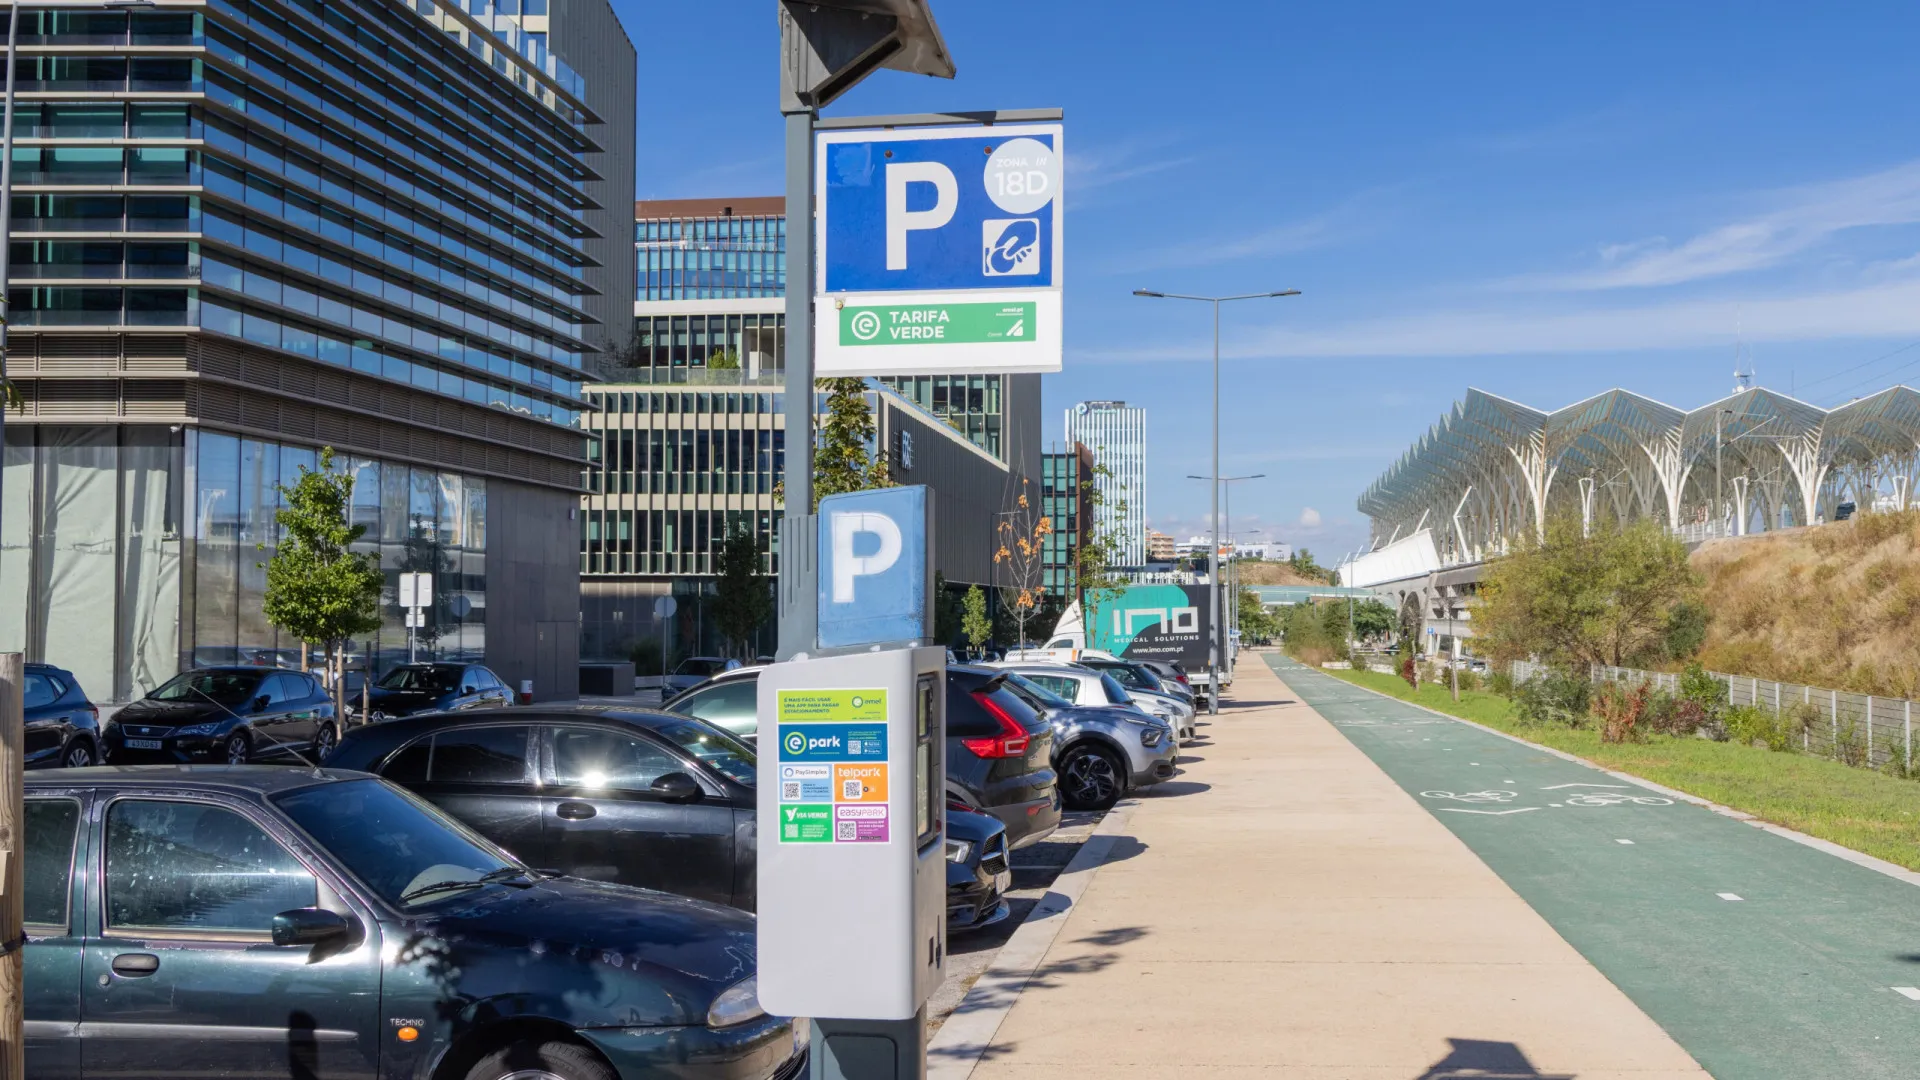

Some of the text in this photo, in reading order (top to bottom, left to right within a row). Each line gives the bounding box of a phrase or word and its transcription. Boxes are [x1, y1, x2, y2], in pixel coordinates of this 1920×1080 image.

[995, 156, 1029, 168] ZONA
[993, 170, 1048, 196] 18D
[885, 161, 959, 271] P
[889, 310, 950, 324] TARIFA
[889, 325, 945, 339] VERDE
[831, 511, 902, 603] P
[1154, 634, 1200, 642] SOLUTIONS
[1132, 646, 1184, 654] www.imo.com.pt
[809, 735, 841, 750] park
[838, 767, 881, 779] telpark
[389, 1018, 425, 1026] TECHNO
